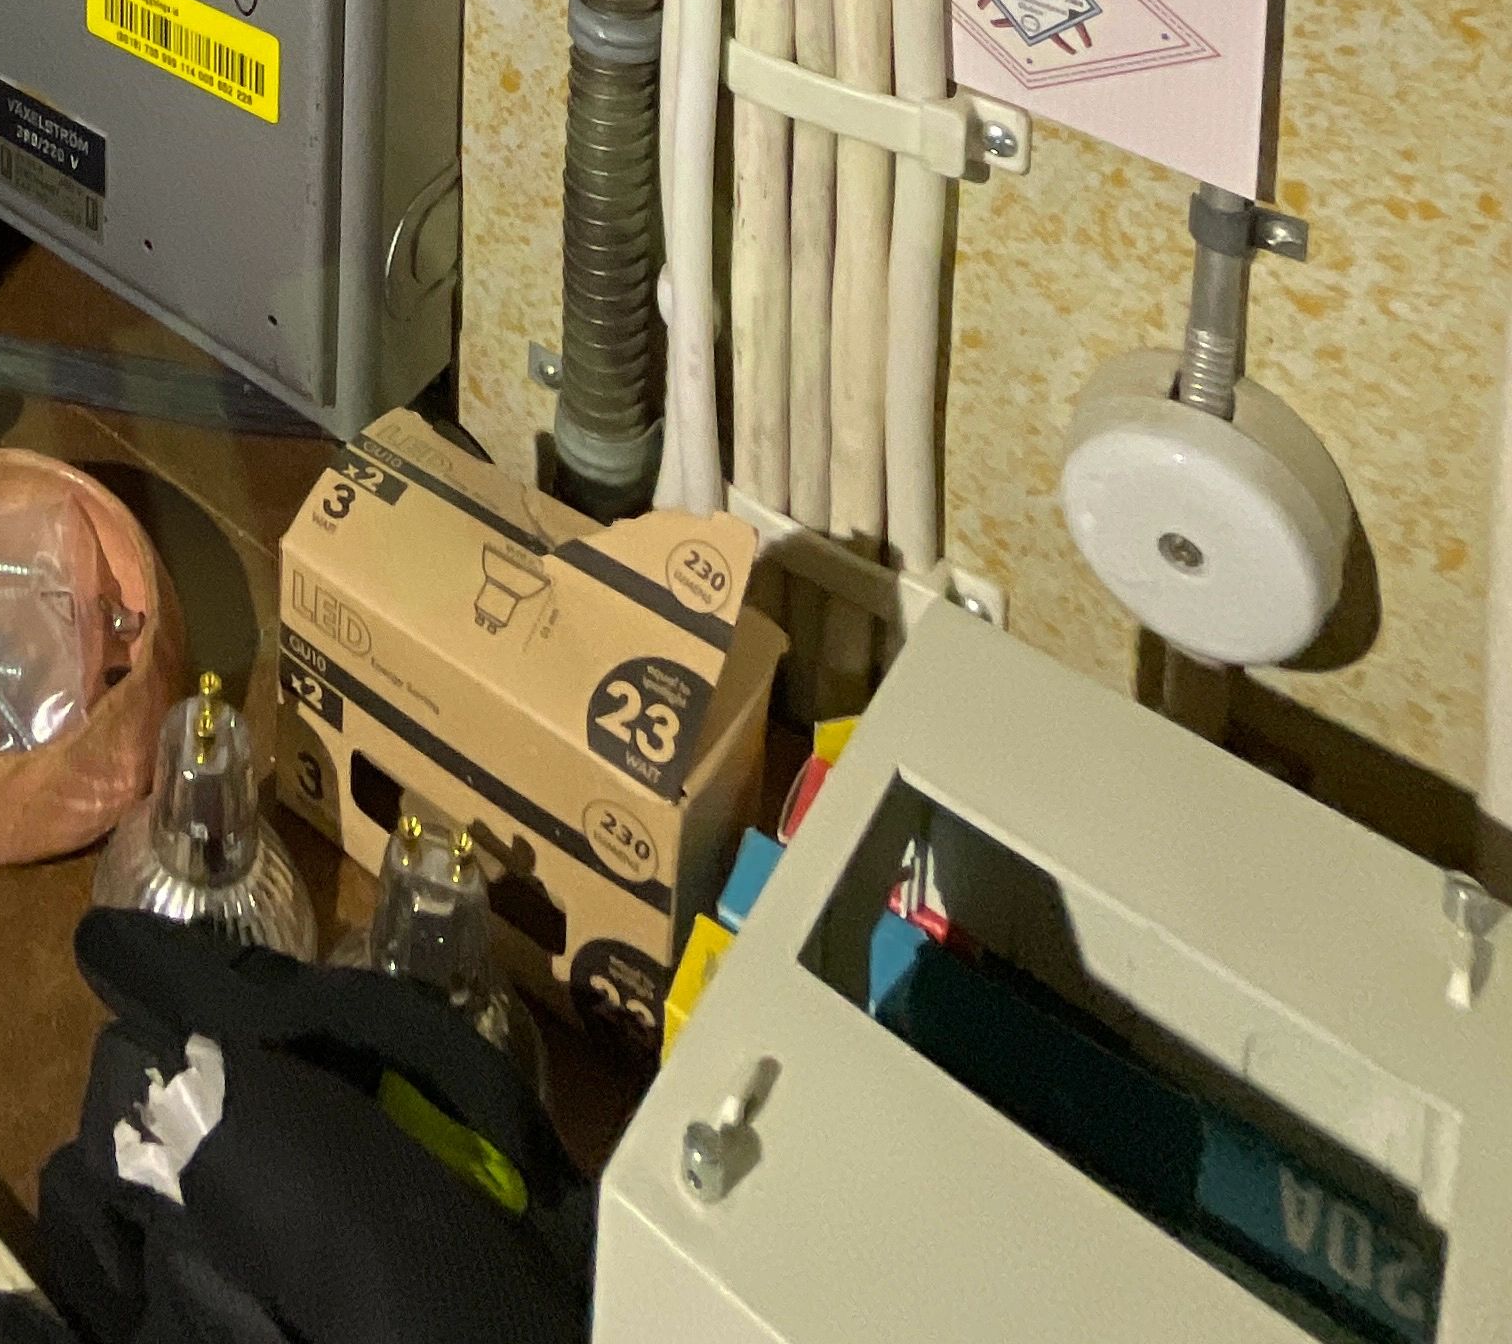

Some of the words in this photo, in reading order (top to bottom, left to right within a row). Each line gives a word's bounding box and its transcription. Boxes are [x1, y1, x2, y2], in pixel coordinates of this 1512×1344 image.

[322, 483, 356, 519] 3
[683, 549, 726, 592] 230
[292, 569, 372, 658] LED
[594, 680, 680, 763] 23
[599, 809, 650, 860] 230
